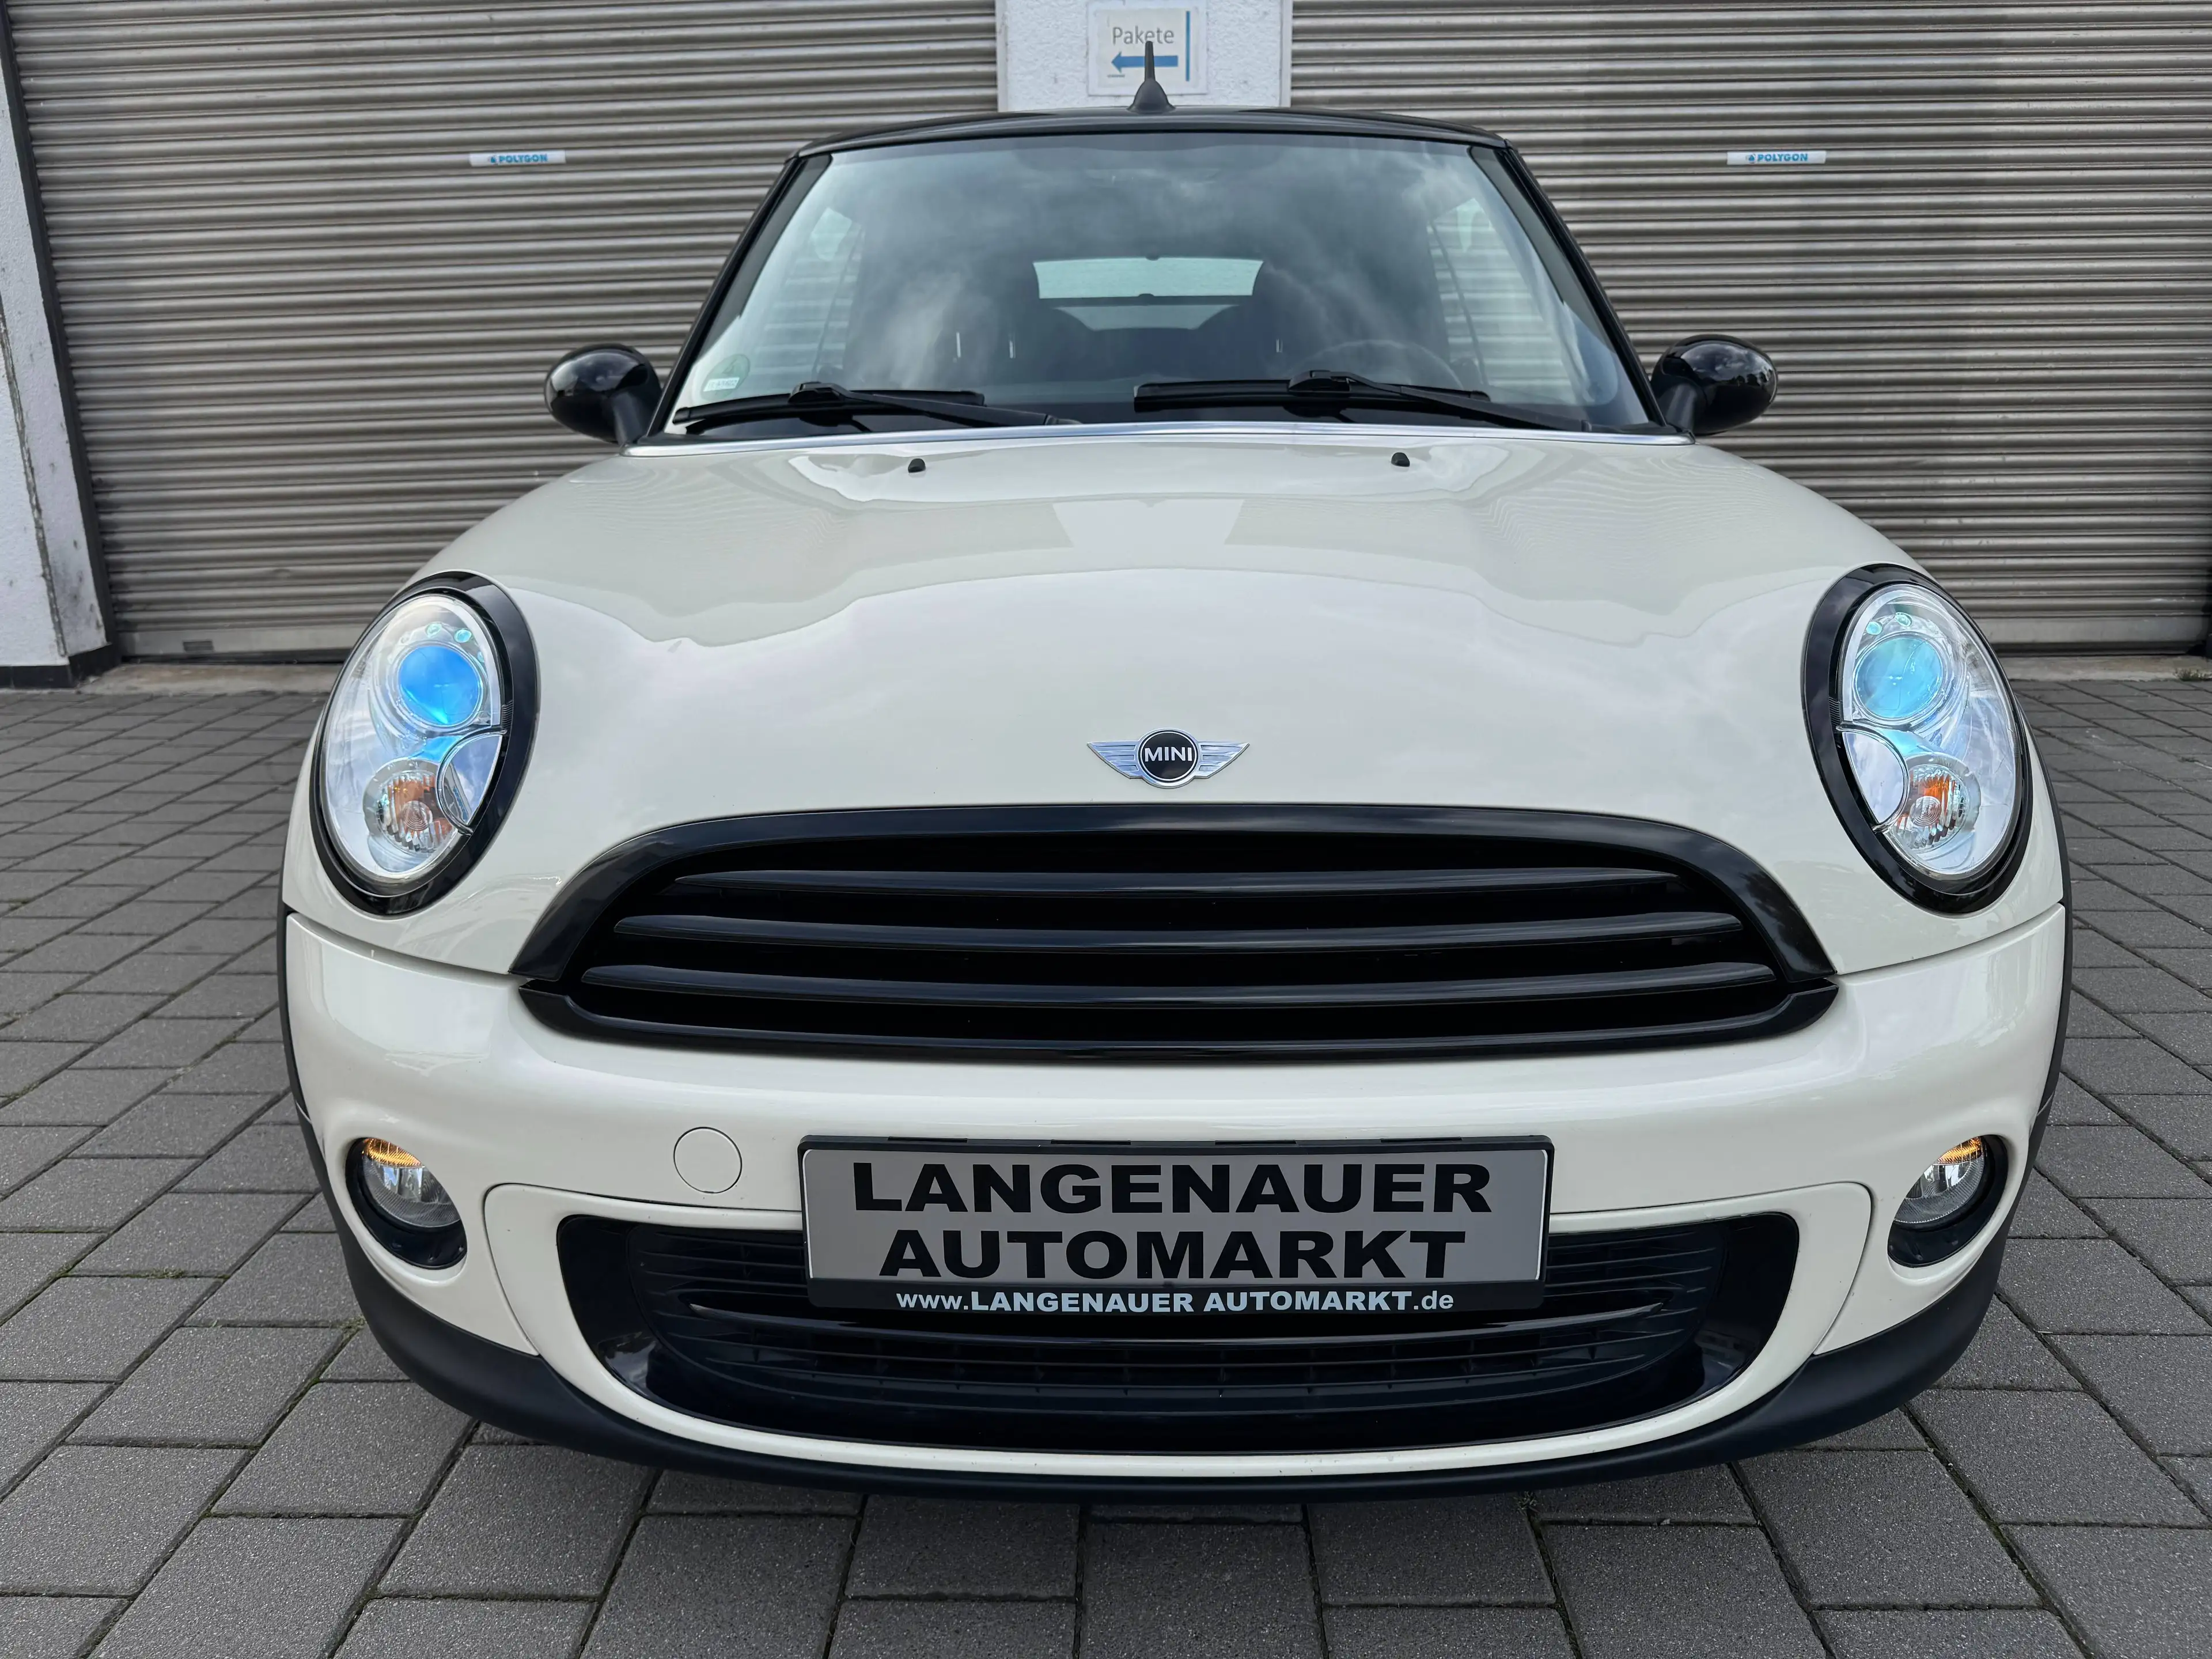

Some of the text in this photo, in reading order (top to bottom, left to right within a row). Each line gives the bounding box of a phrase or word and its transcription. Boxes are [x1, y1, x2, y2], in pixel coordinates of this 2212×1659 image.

[1112, 25, 1175, 44] Pakete
[499, 154, 548, 163] POLYGON
[1758, 154, 1808, 162] POLYGON
[1145, 747, 1192, 762] MINI
[853, 1162, 1492, 1214] LANGENAUER
[878, 1229, 1466, 1279] AUTOMARKT
[896, 1290, 1455, 1313] www.LANGENAUER AUTOMARKT.de
